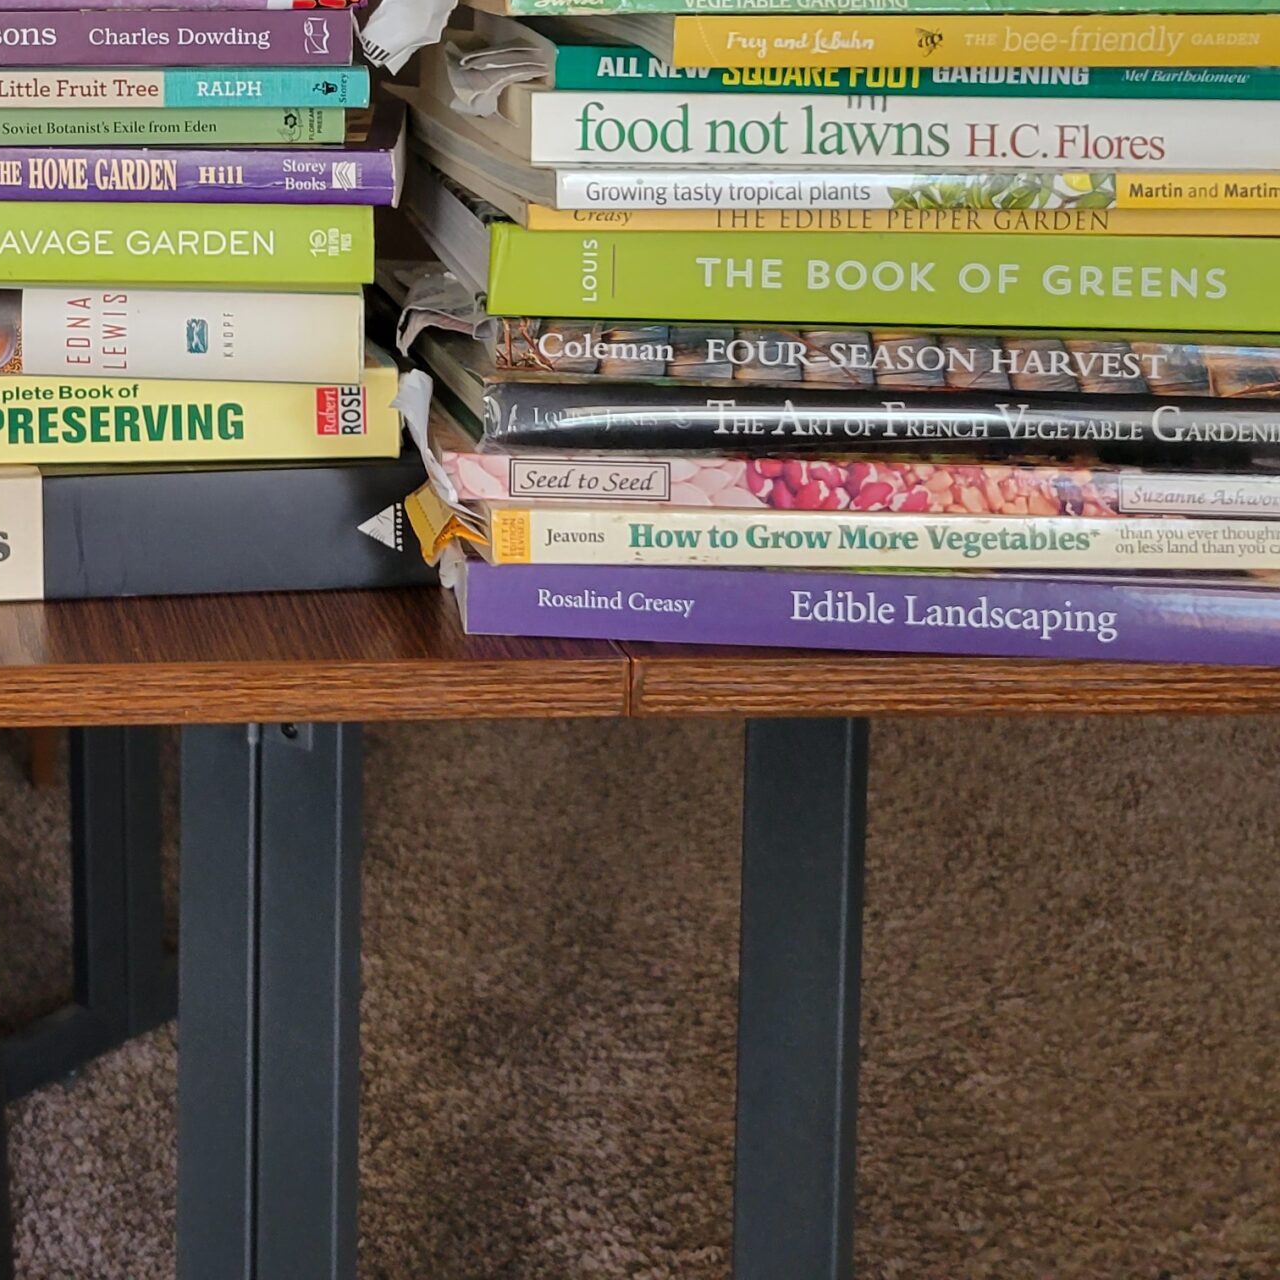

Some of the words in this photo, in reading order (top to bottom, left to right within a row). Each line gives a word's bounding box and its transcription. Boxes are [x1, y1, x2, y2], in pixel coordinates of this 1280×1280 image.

[197, 81, 262, 96] RALPH
[576, 102, 693, 152] food
[705, 112, 788, 154] not
[805, 105, 950, 157] lawns
[965, 123, 1048, 159] H.C.
[1054, 124, 1165, 161] Flores
[283, 160, 326, 173] Storey
[285, 176, 326, 190] Books
[586, 182, 667, 205] Growing
[674, 184, 722, 204] tasty
[729, 183, 802, 204] tropical
[810, 183, 871, 203] plants
[583, 239, 598, 302] LOUIS
[696, 258, 783, 288] THE
[807, 260, 936, 292] BOOK
[959, 263, 1019, 293] OF
[1043, 265, 1227, 298] GREENS
[67, 297, 91, 364] EDNA
[103, 294, 127, 369] LEWIS
[224, 312, 233, 357] KNOPF
[537, 333, 675, 361] Coleman
[520, 470, 570, 489] Seed
[578, 474, 599, 489] to
[602, 472, 654, 491] Seed
[545, 528, 605, 545] Jeavons
[537, 589, 623, 610] Rosalind
[628, 593, 694, 617] Creasy
[790, 590, 895, 624] Edible
[904, 597, 1118, 643] Landscaping
